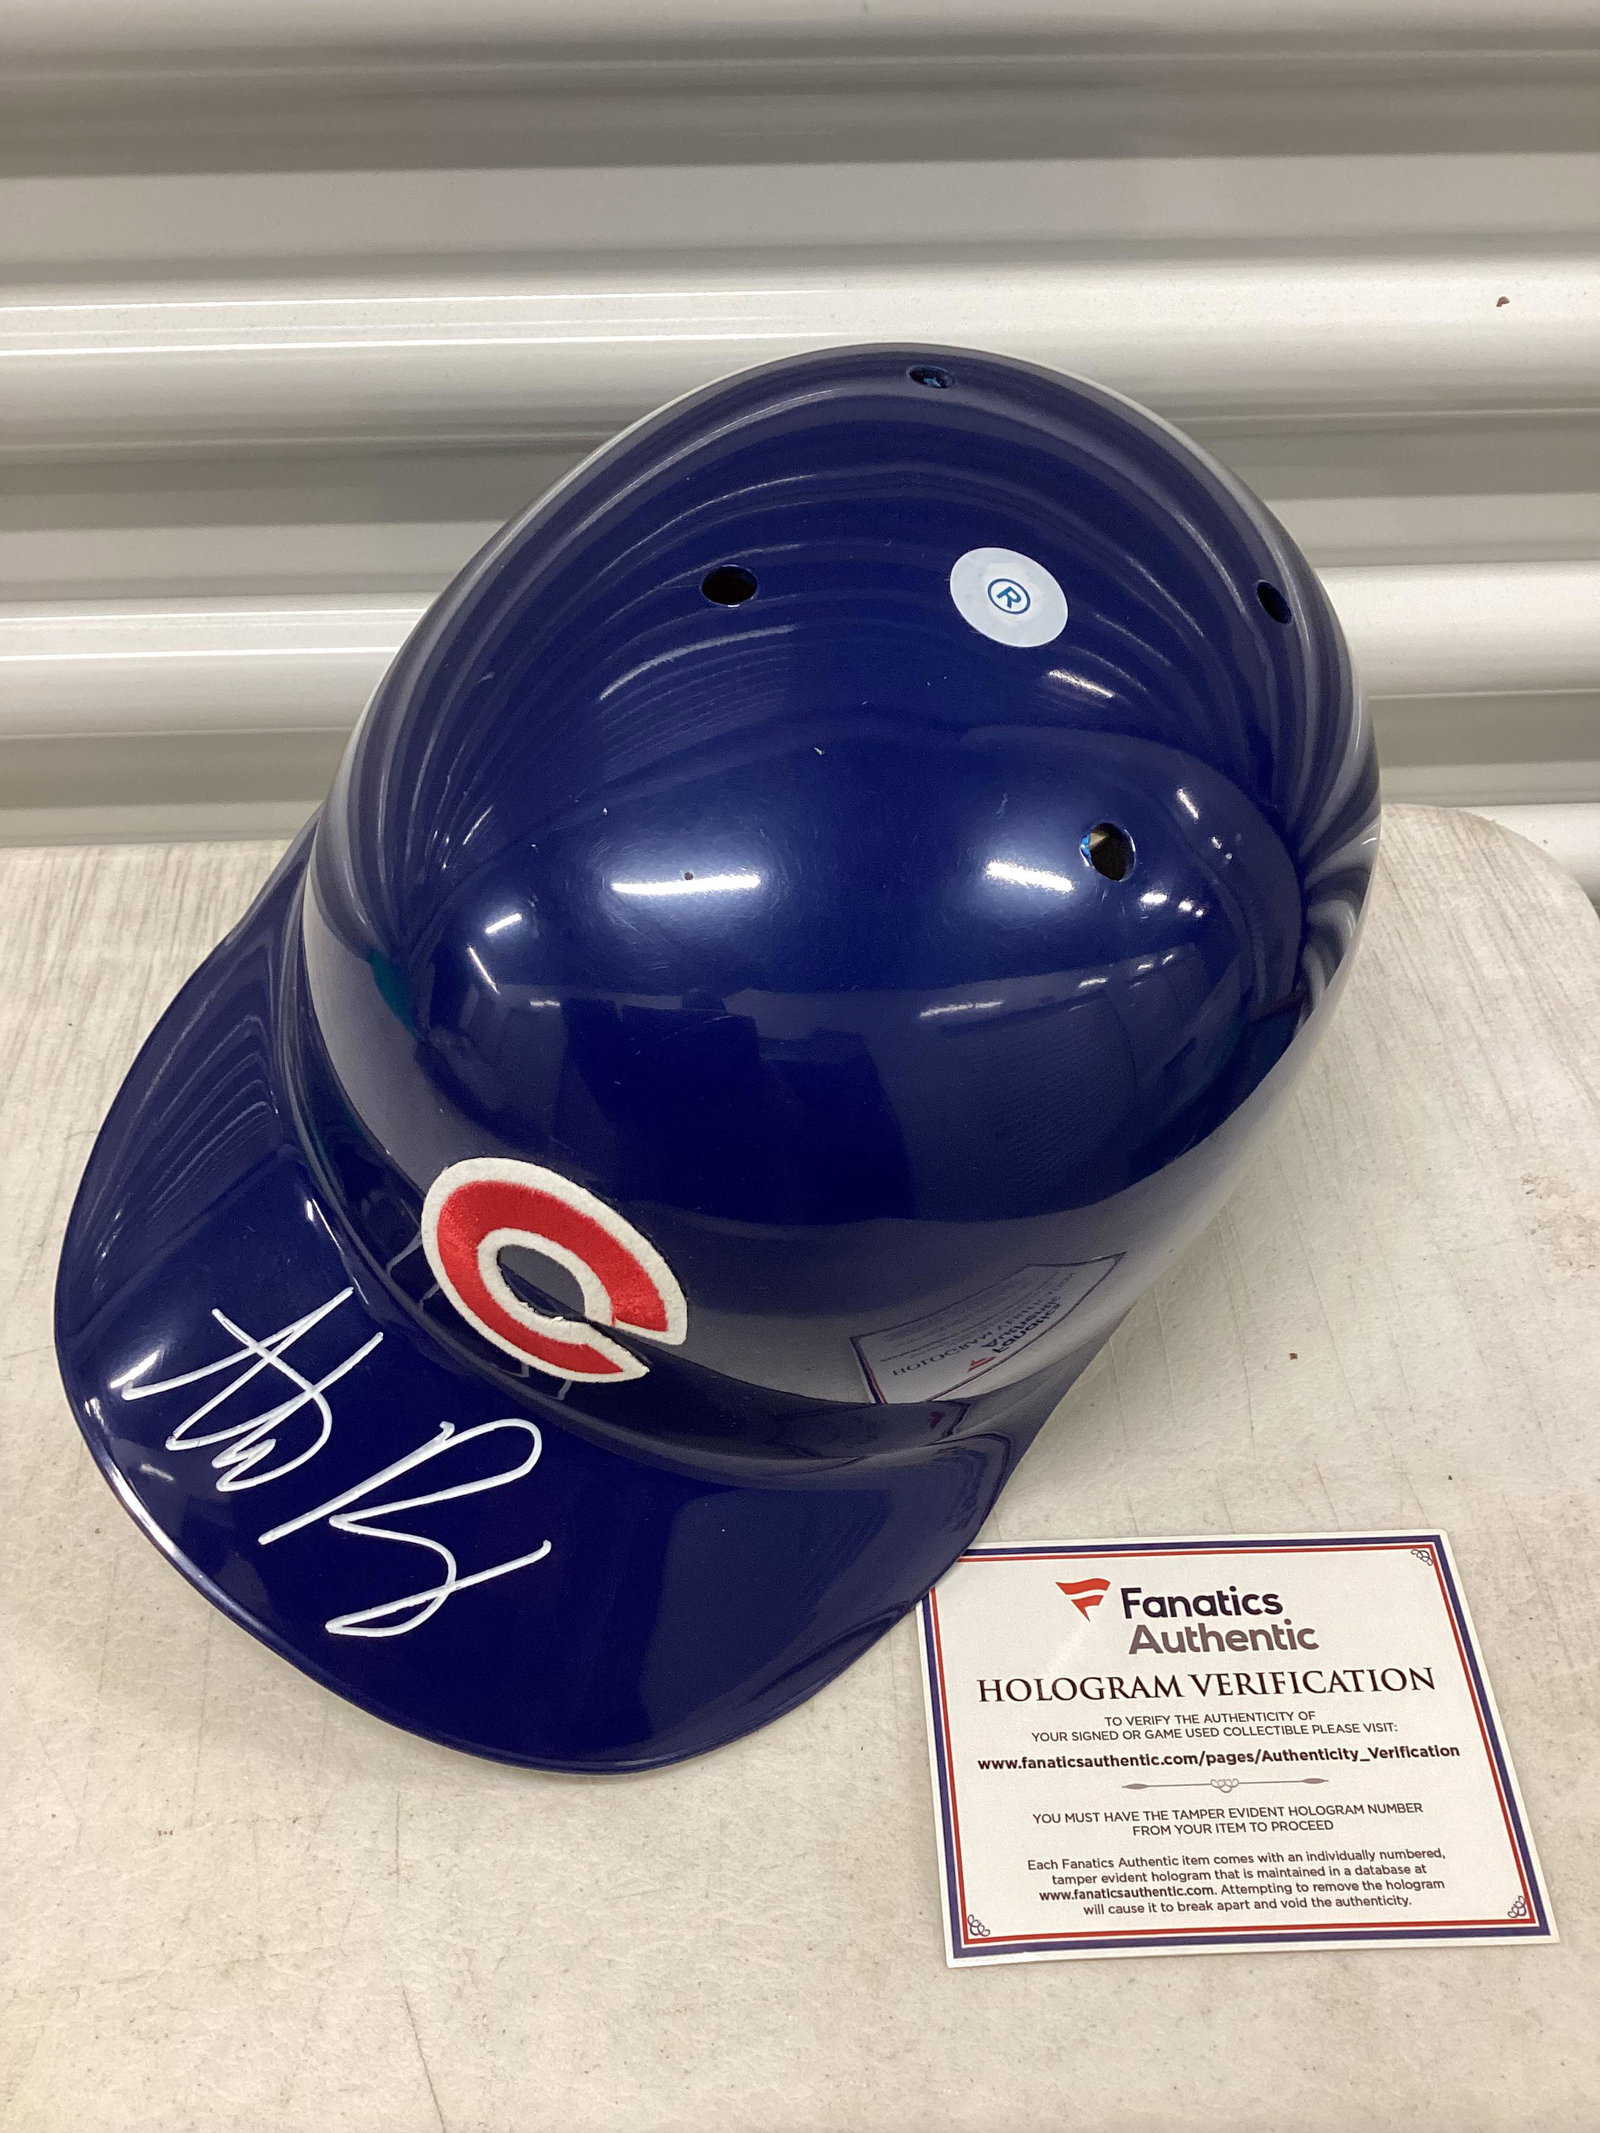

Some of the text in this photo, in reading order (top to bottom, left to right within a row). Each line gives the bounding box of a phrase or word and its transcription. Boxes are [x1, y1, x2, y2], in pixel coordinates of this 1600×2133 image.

[421, 1157, 688, 1383] C
[1120, 1586, 1283, 1619] Fanatics
[1128, 1618, 1320, 1655] Authentic
[976, 1667, 1435, 1702] HOLOGRAM VERIFICATION
[1104, 1711, 1316, 1726] TO VERIFY THE AUTHENTICITY OF
[1031, 1722, 1398, 1742] YOUR SIGNED OR GAME USED COLLECTIBLE PLEASE VISIT:
[978, 1745, 1460, 1770] www.fanaticsauthentic.com/pages/Authenticity_Verification
[1032, 1803, 1424, 1824] YOU MUST HAVE THE TAMPER EVIDENT HOLOGRAM NUMBER
[1132, 1820, 1334, 1836] FROM YOUR ITEM TO PROCEED
[1028, 1848, 1445, 1870] Each Fanatics Authentic item comes with an individually numbered,
[1052, 1864, 1427, 1886] tamper evident hologram that is maintained in a database at
[1039, 1879, 1445, 1901] www.fanaticsauthentic.com. Attempting to remove the hologram
[1083, 1895, 1412, 1915] will cause it to break apart and void the authenticity.
